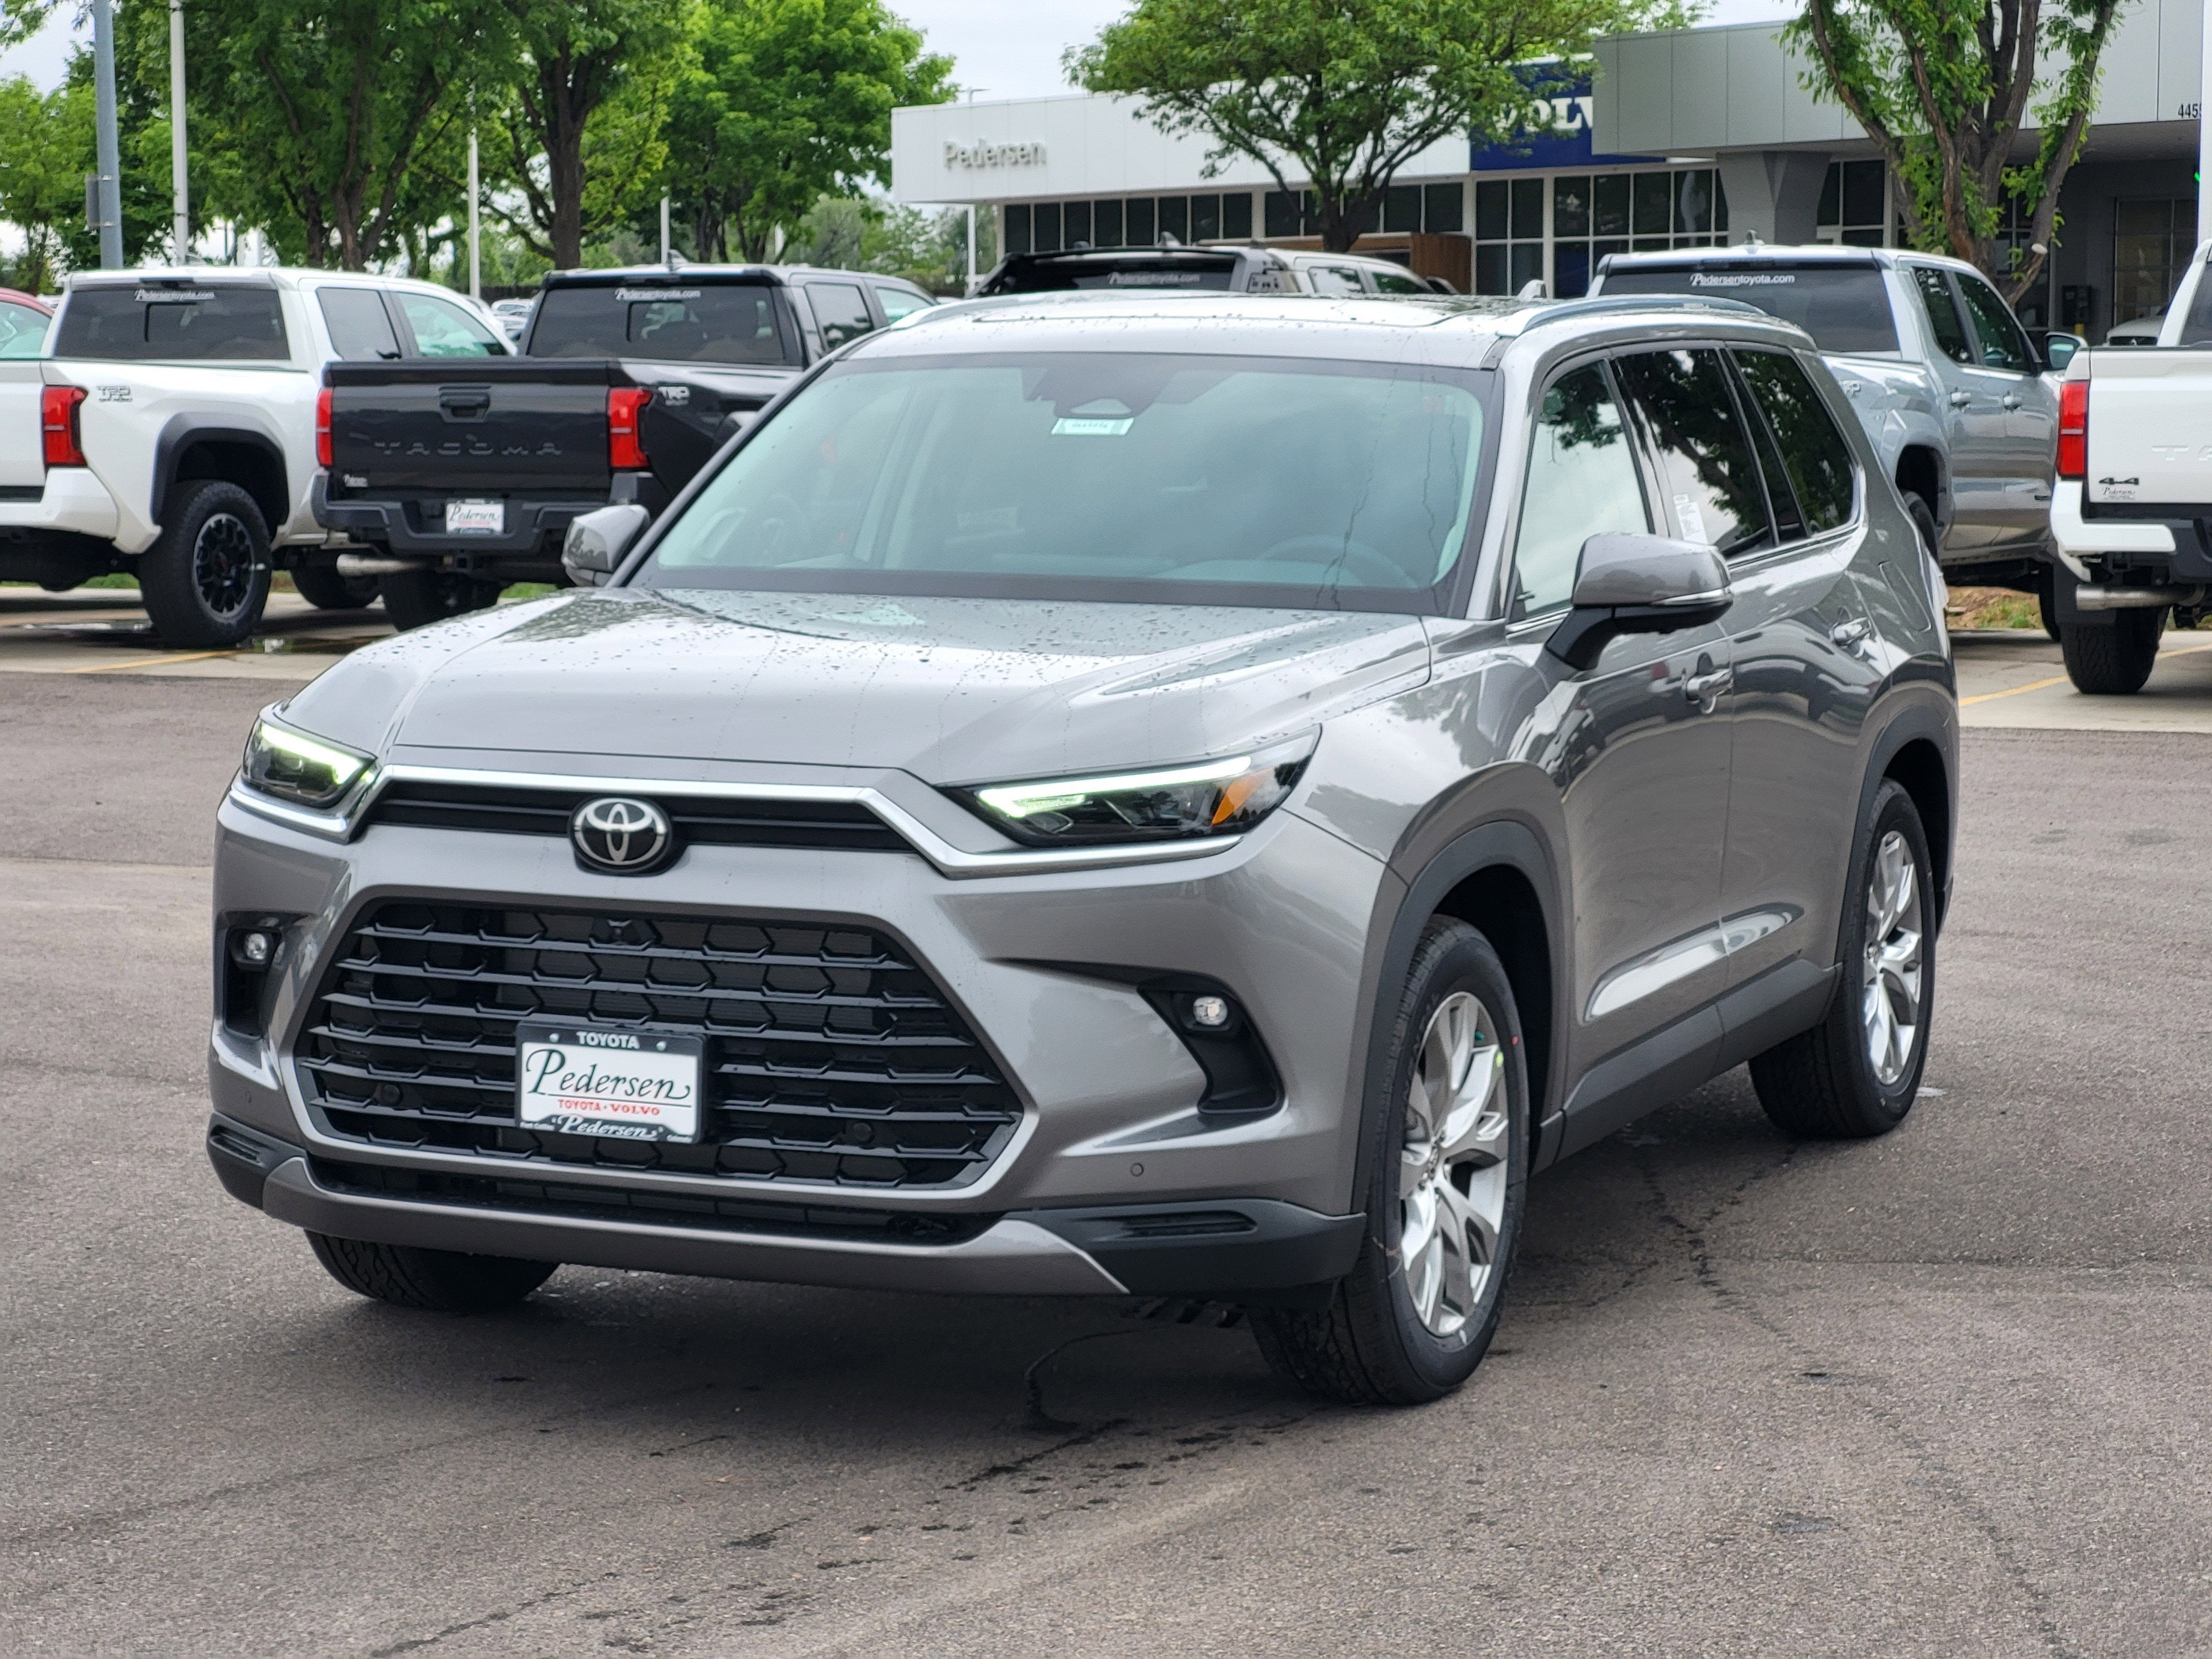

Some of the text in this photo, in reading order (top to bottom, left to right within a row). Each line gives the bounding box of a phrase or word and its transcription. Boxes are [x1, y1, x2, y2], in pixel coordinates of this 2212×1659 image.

[943, 139, 1047, 170] Pedersen
[1690, 273, 1795, 286] Pedersentoyota.com
[658, 386, 690, 399] TRD
[374, 441, 562, 455] TACOMA
[576, 1031, 640, 1049] TOYOTA
[526, 1048, 691, 1099] Pedersen
[557, 1099, 660, 1116] TOYOTA VOLVO
[557, 1114, 657, 1139] Pedersen
